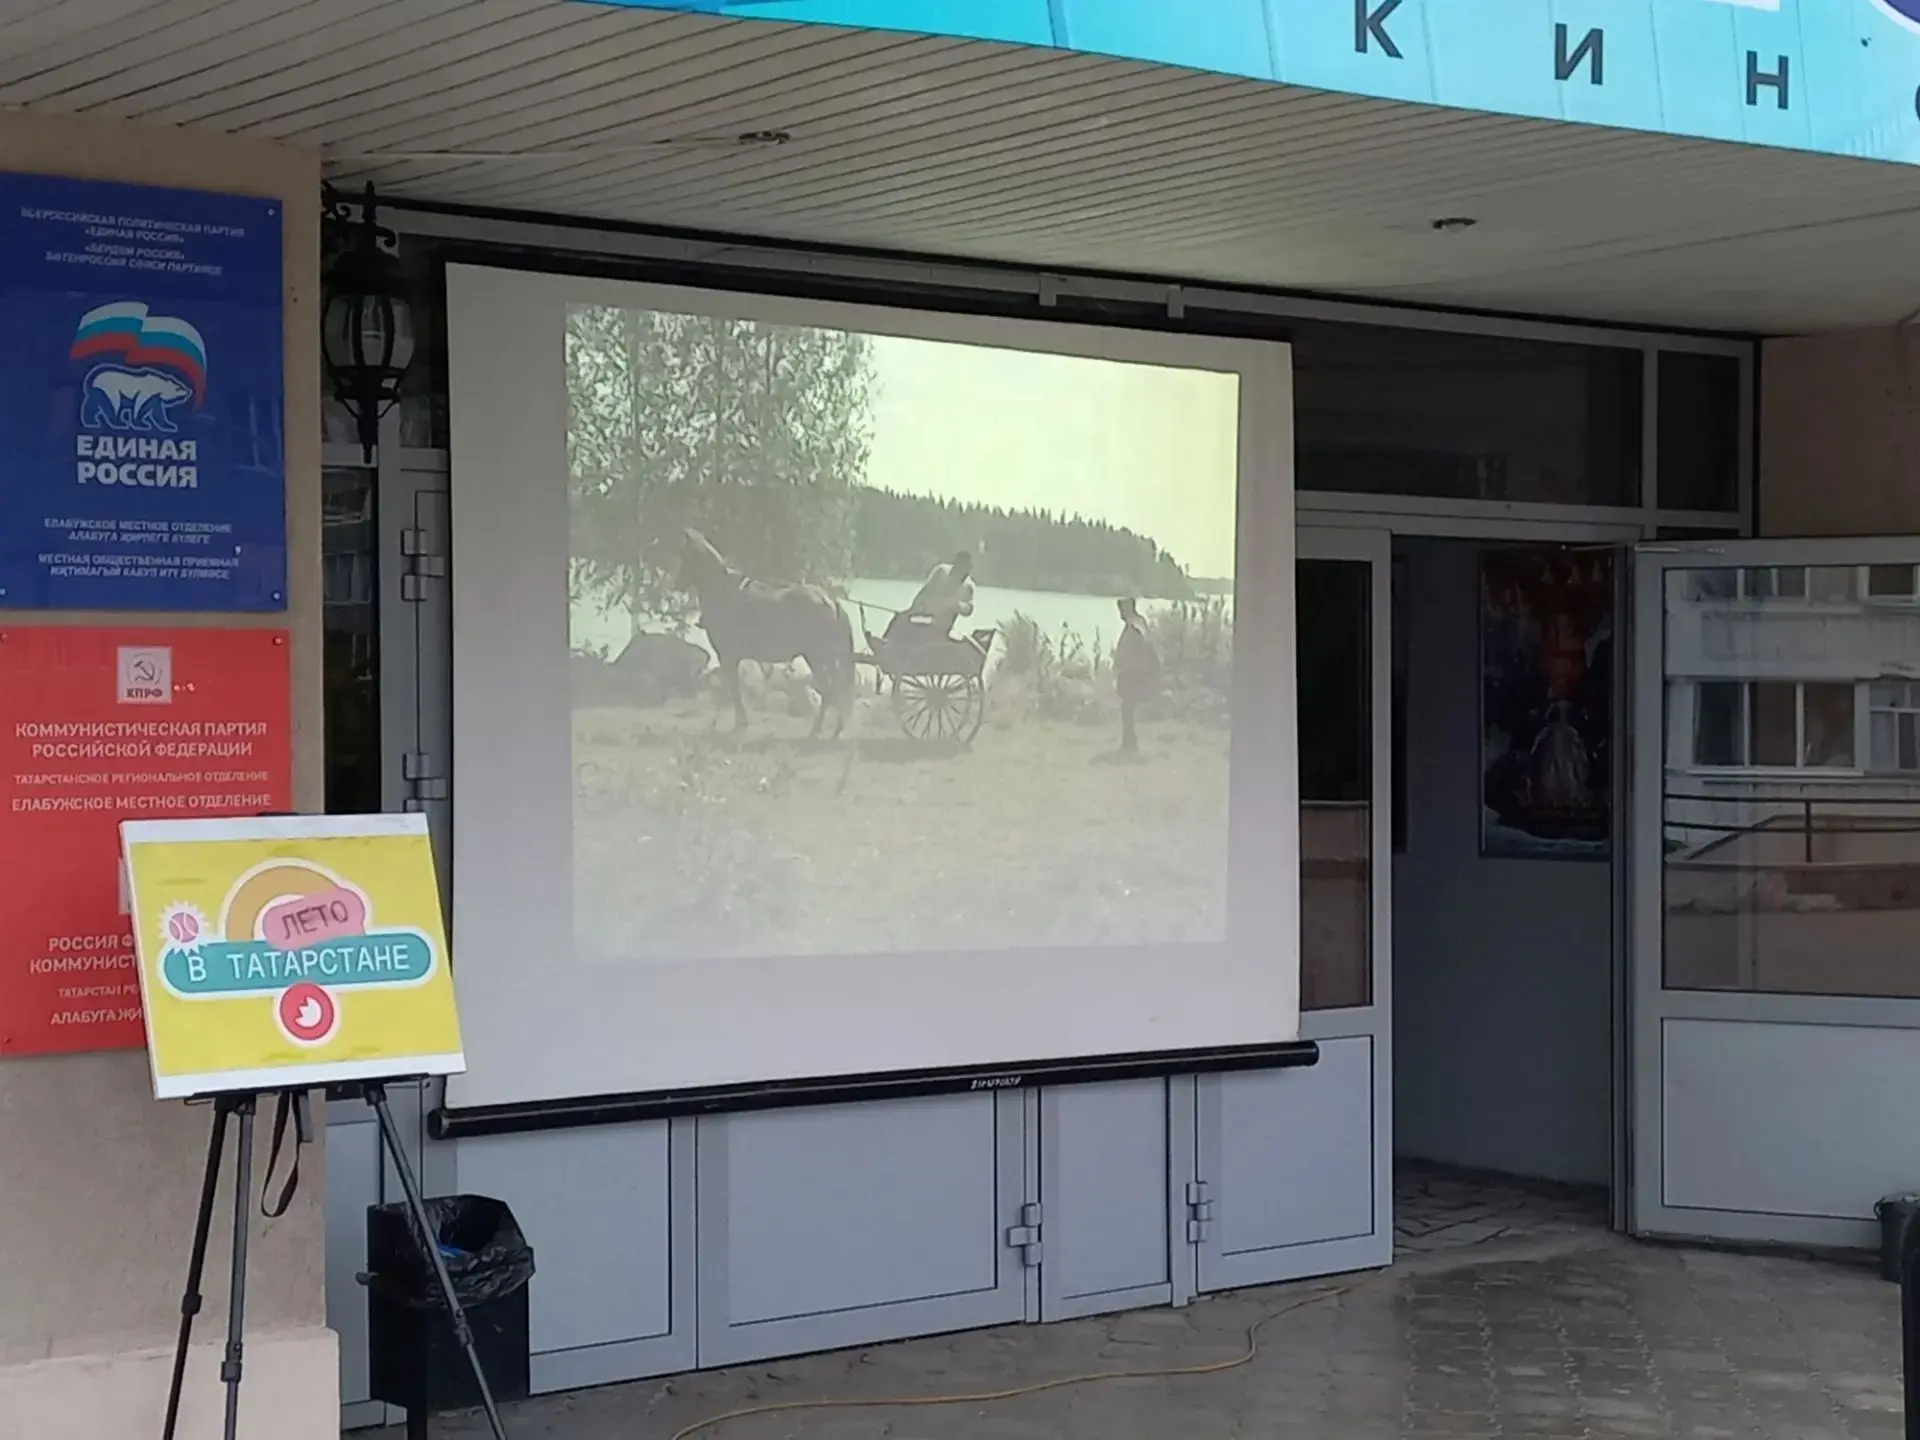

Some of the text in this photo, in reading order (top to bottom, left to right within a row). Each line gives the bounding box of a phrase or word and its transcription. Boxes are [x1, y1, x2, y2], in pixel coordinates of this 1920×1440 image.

[76, 434, 197, 462] ЕДИНАЯ
[77, 461, 198, 488] РОССИЯ
[126, 687, 163, 699] КПРФ
[15, 722, 267, 738] КОММУНИСТИЧЕСКАЯ ПАРТИЯ
[32, 739, 252, 758] РОССИЙСКОЙ ФЕДЕРАЦИИ
[111, 771, 201, 784] РЕГИОНАЛЬНОЕ
[204, 770, 268, 783] ОТДЕЛЕНИЕ
[12, 793, 271, 812] ЕЛАБУЖСКОЕ МЕСТНОЕ ОТДЕЛЕНИЕ
[281, 900, 349, 940] ЛЕТО
[48, 934, 118, 952] РОССИЯ
[29, 954, 136, 975] КОММУНИСТ
[188, 943, 411, 982] В ТАТАРСТАНЕ
[50, 1008, 116, 1025] АЛАБУГА
